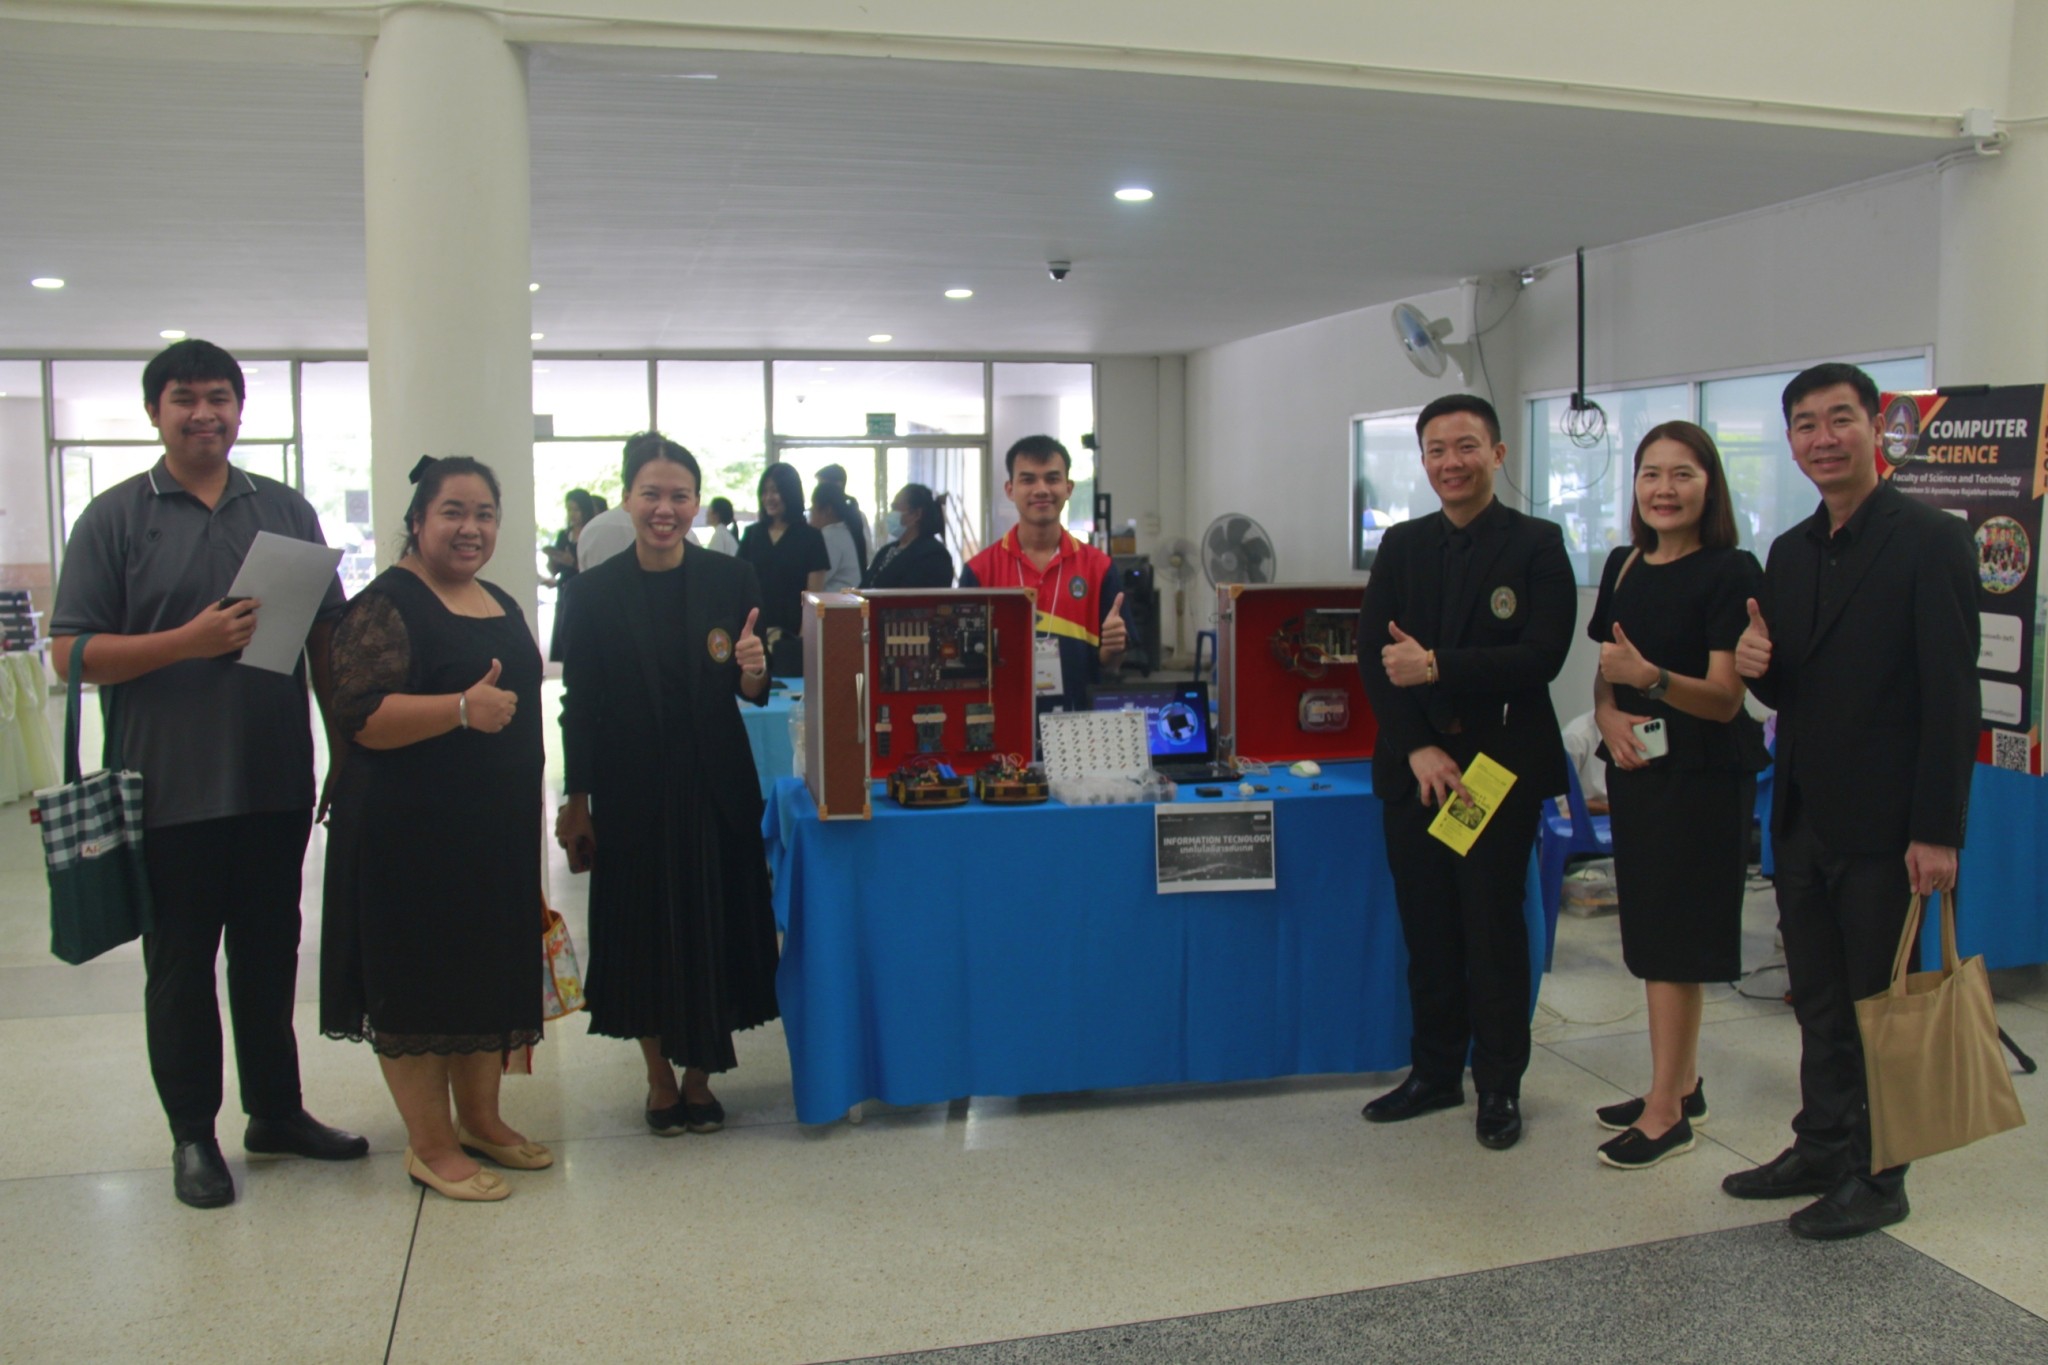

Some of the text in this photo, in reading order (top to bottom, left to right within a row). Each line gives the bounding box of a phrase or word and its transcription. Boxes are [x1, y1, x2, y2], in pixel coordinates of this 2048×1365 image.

[1929, 418, 2028, 439] COMPUTER
[1926, 445, 1999, 464] SCIENCE
[1892, 472, 2021, 487] Faculty of Science and Technology
[1163, 835, 1221, 846] INFORMATION
